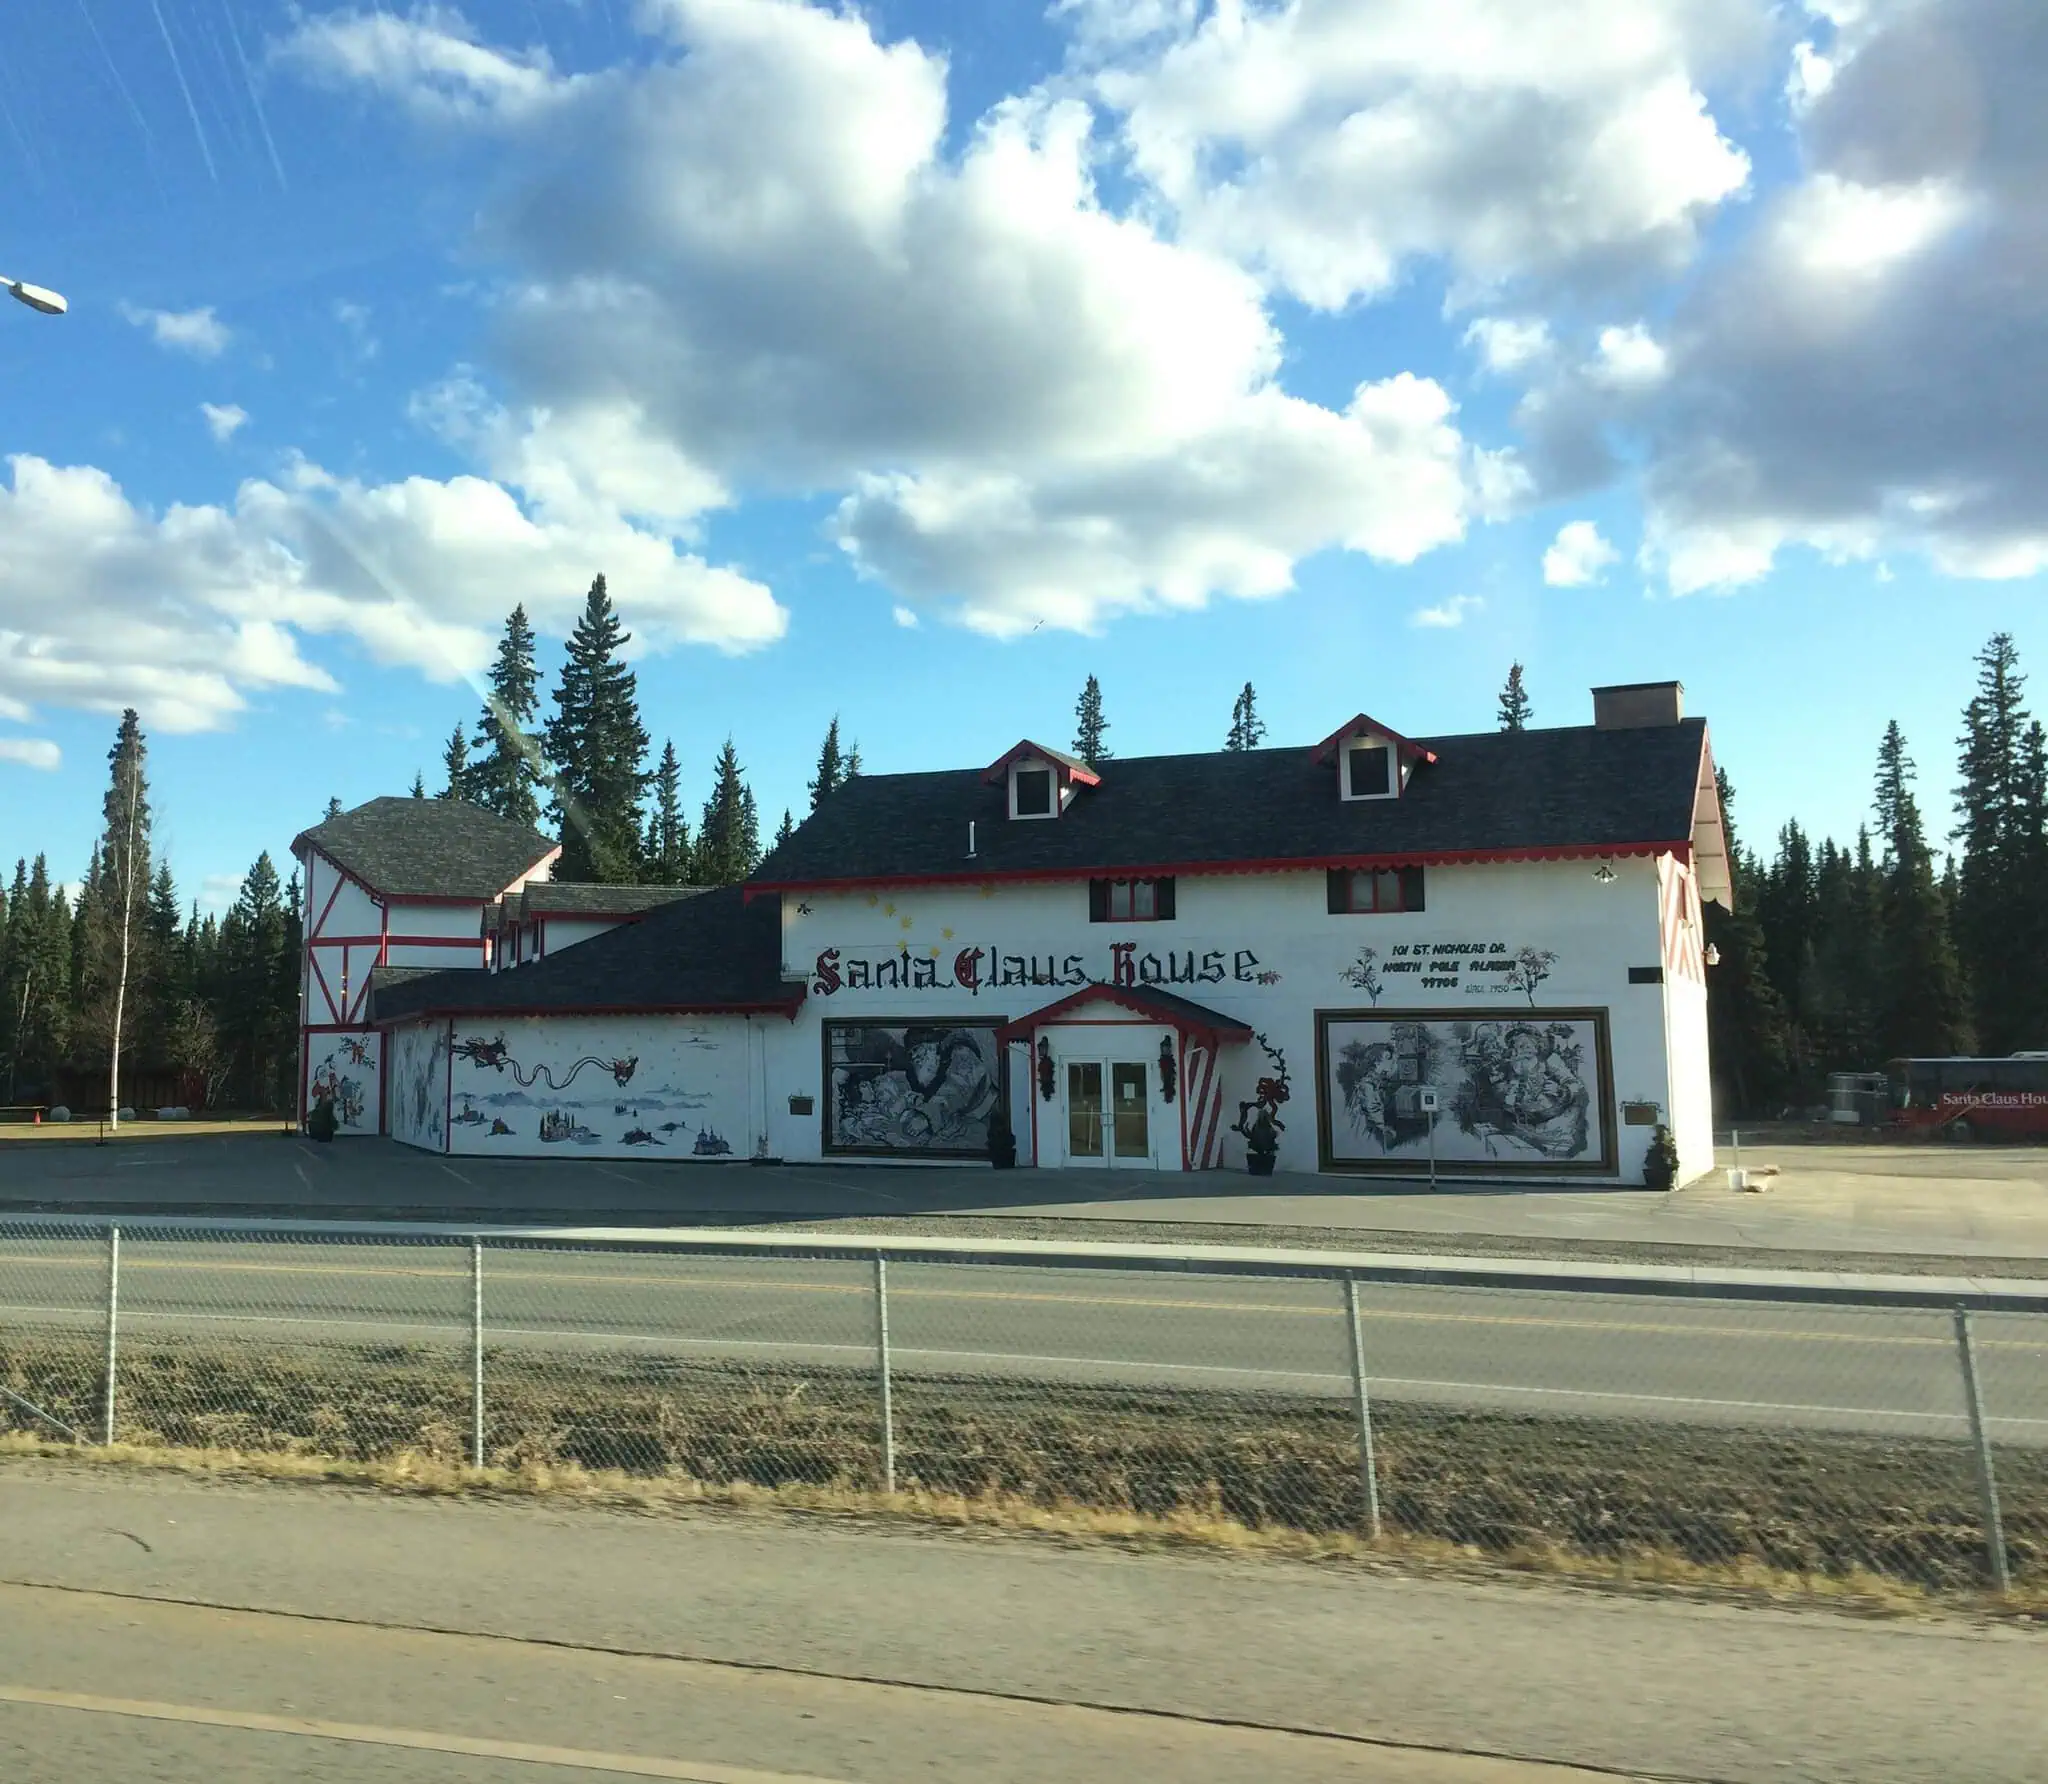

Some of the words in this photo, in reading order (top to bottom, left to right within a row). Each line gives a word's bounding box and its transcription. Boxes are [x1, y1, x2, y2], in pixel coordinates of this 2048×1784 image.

[1391, 945, 1409, 956] 101
[1412, 944, 1430, 955] ST.
[1432, 943, 1486, 955] NICHOLAS
[1489, 943, 1506, 954] DR.
[813, 947, 954, 996] Santa
[954, 946, 1085, 996] Claus
[1109, 940, 1262, 989] House
[1382, 961, 1422, 973] NORTH
[1429, 961, 1460, 972] POLE
[1943, 1092, 1981, 1105] Santa
[1981, 1092, 2018, 1105] Claus
